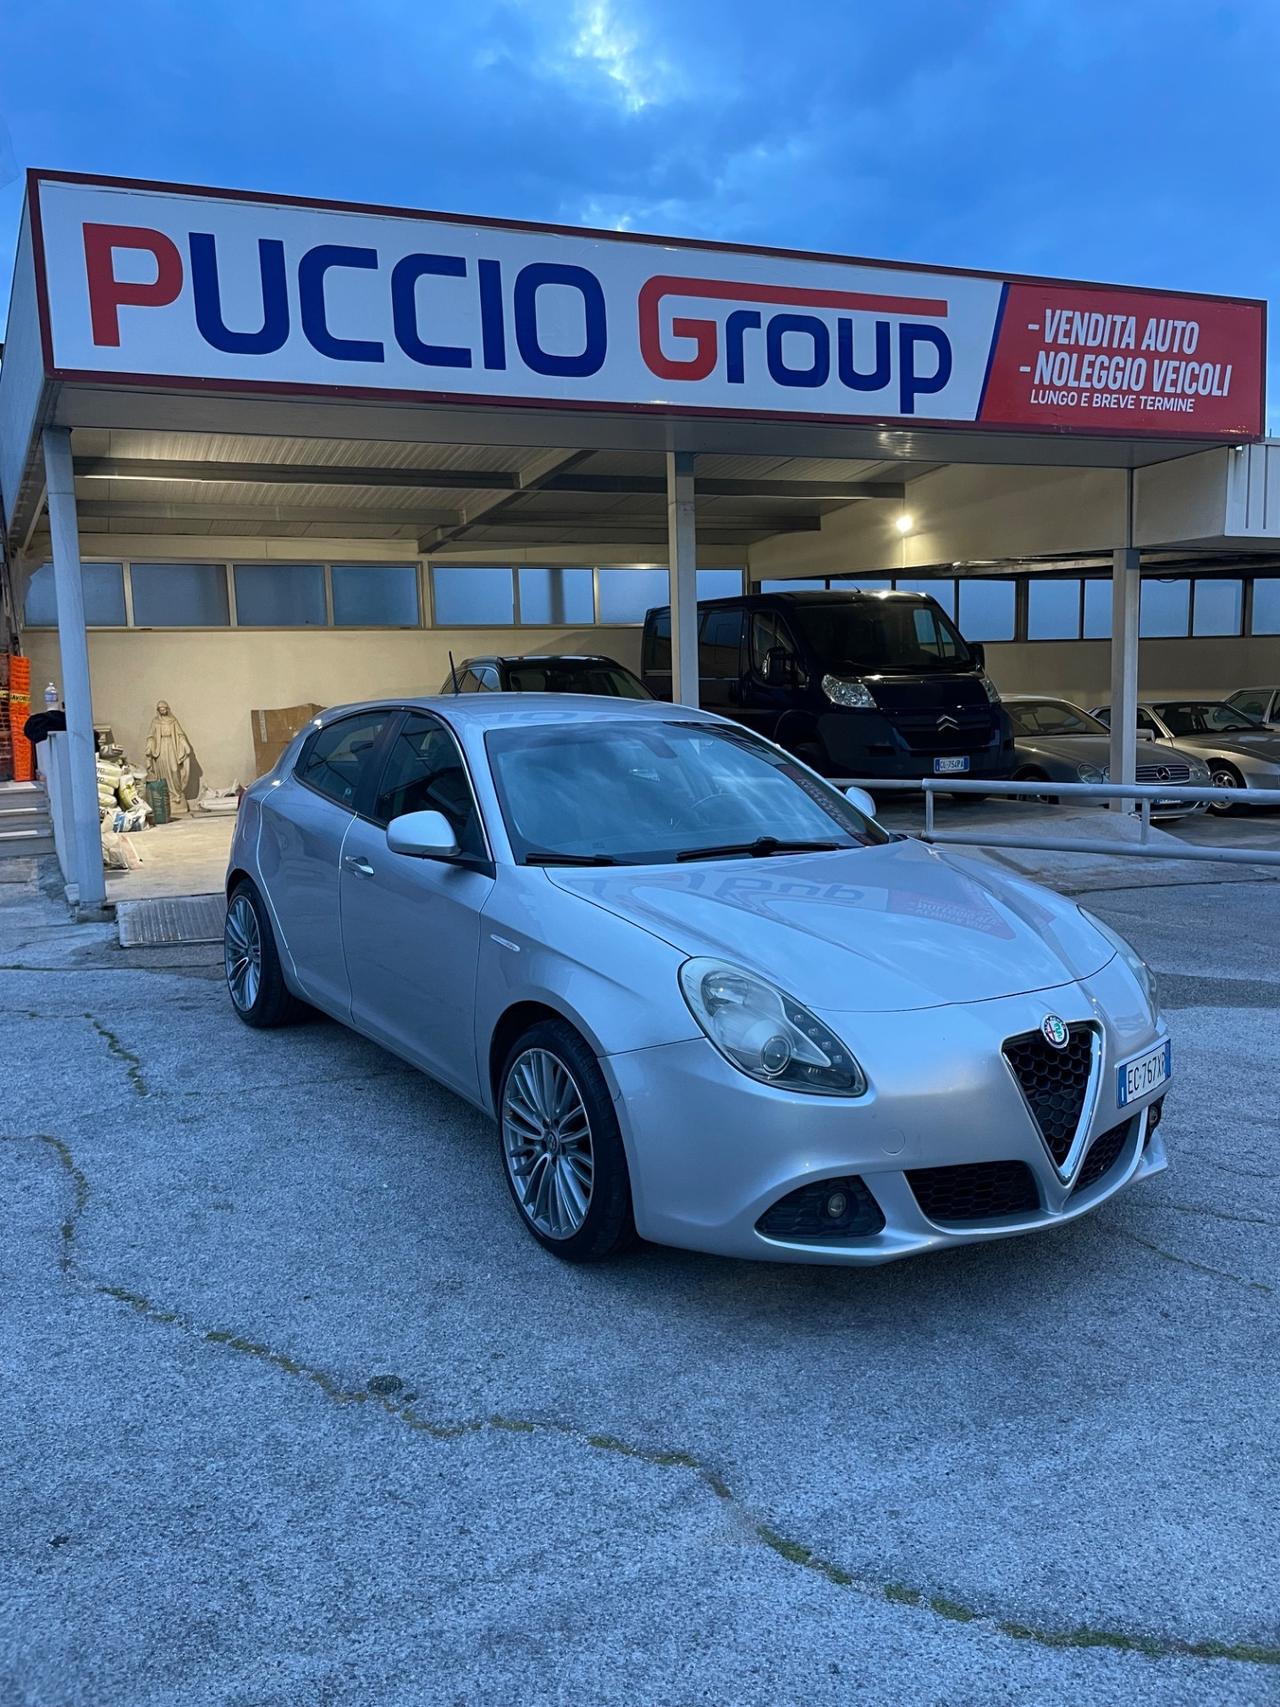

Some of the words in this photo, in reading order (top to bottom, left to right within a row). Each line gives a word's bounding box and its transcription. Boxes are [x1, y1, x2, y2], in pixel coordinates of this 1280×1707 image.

[82, 222, 607, 378] PUCCIO
[638, 275, 953, 415] Group
[1141, 318, 1200, 355] AUTO
[1152, 359, 1232, 397] VEICOLI
[1030, 389, 1078, 407] LUNGO
[1081, 392, 1090, 407] E
[1092, 393, 1137, 410] BREVE
[1140, 396, 1195, 413] TERMINE
